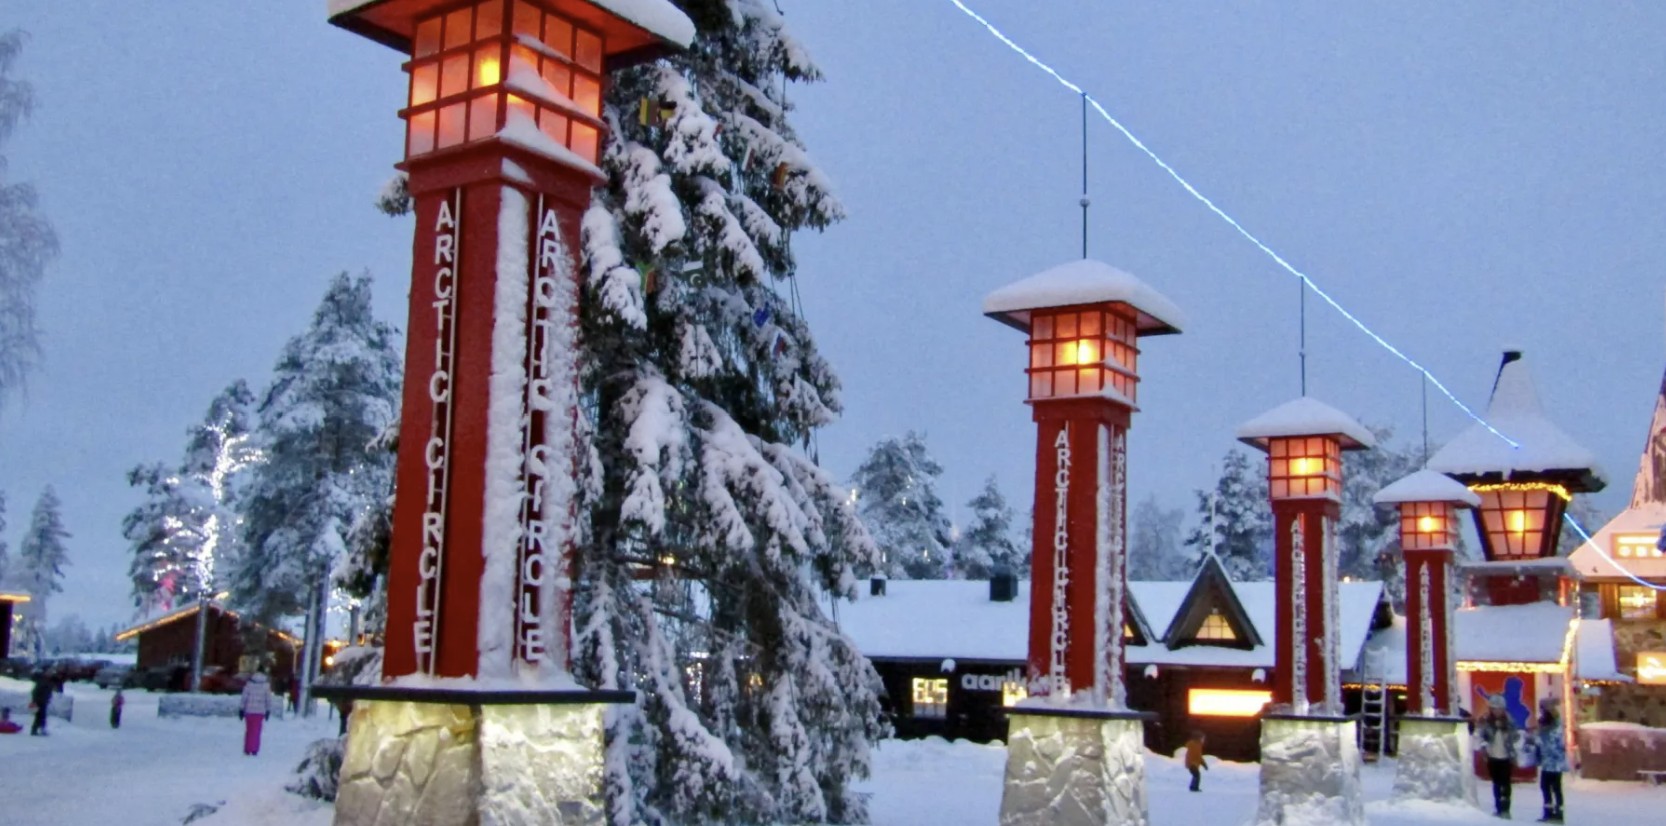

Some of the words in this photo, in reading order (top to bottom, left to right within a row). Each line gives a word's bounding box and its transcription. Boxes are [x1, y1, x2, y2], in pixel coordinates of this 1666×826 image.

[429, 201, 454, 403] ARCTIC
[530, 209, 561, 411] ARCTIC
[413, 437, 443, 654] CIRCLE
[1054, 430, 1071, 550] ARCTIC
